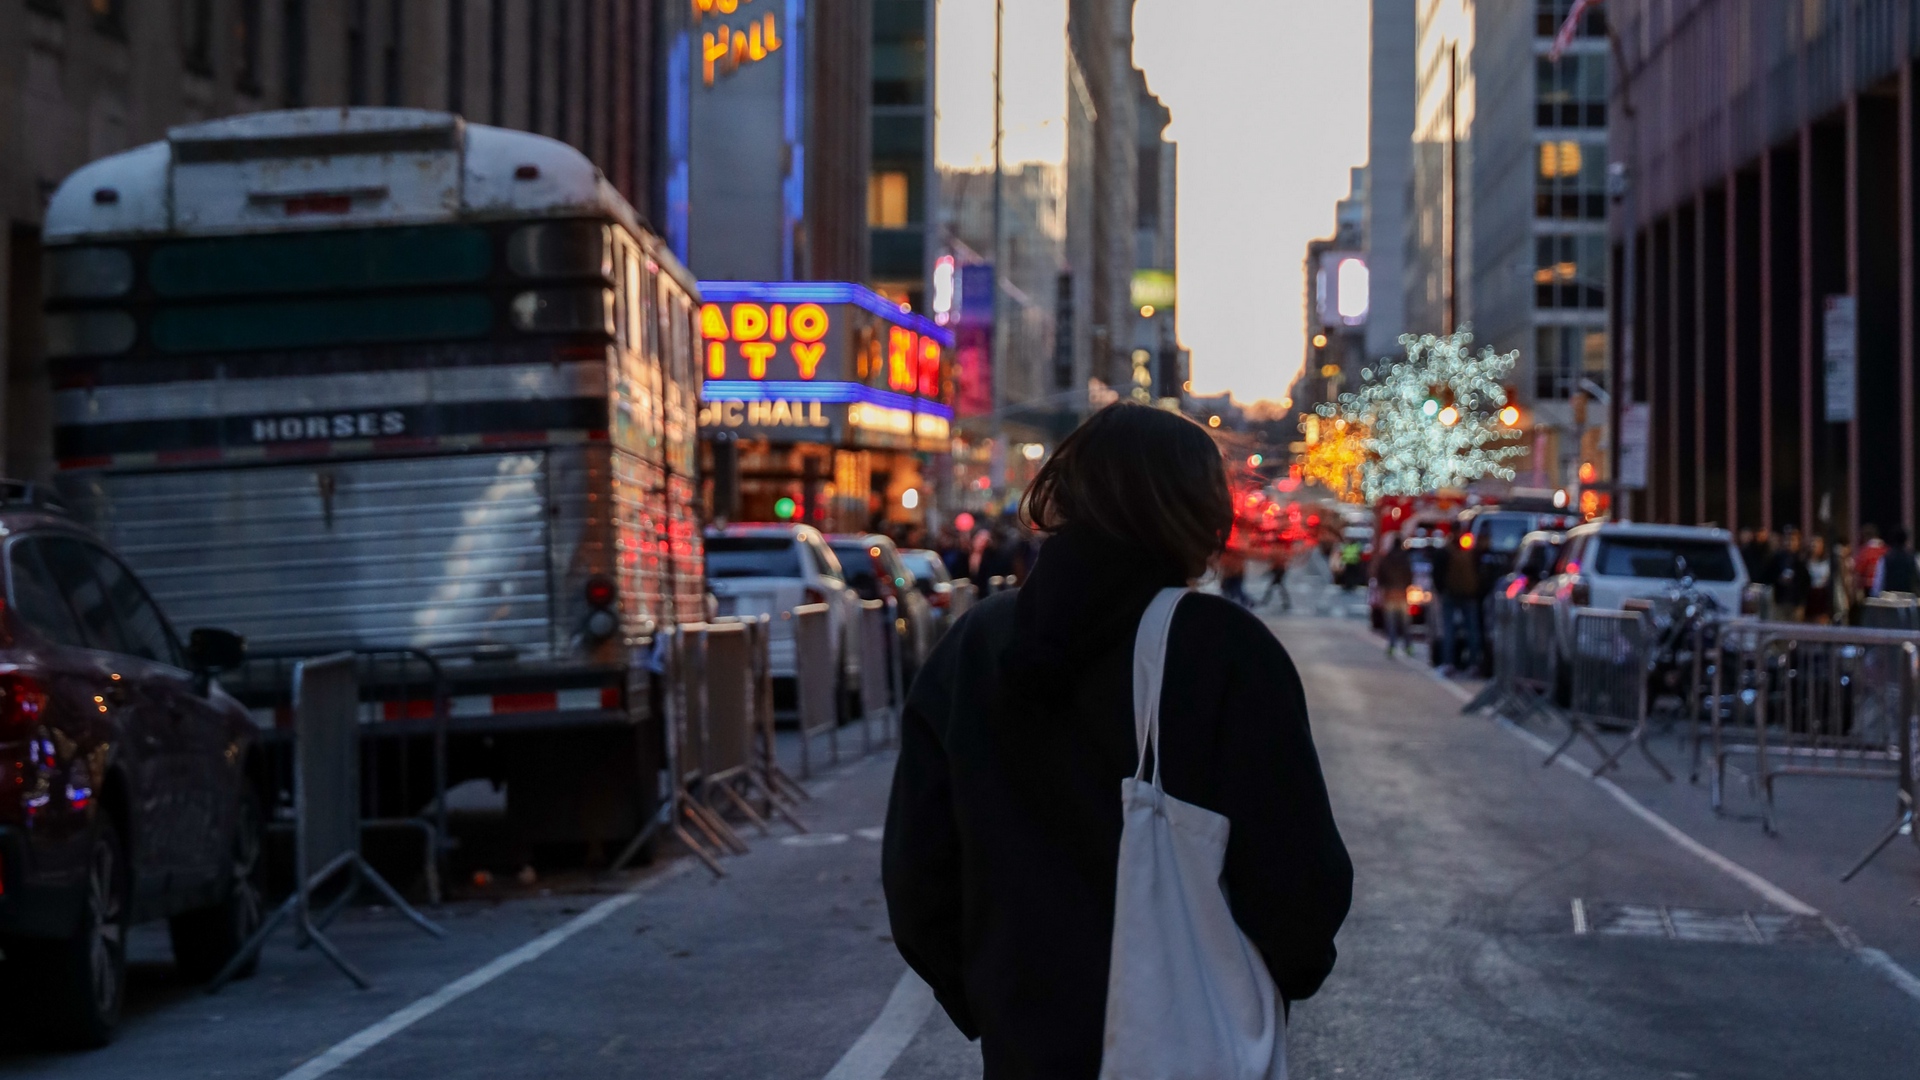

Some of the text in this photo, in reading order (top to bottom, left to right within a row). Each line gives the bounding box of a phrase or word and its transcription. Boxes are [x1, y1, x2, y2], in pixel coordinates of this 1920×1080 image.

[702, 11, 782, 88] HALL
[252, 411, 405, 442] HORSES
[747, 397, 830, 427] HALL
